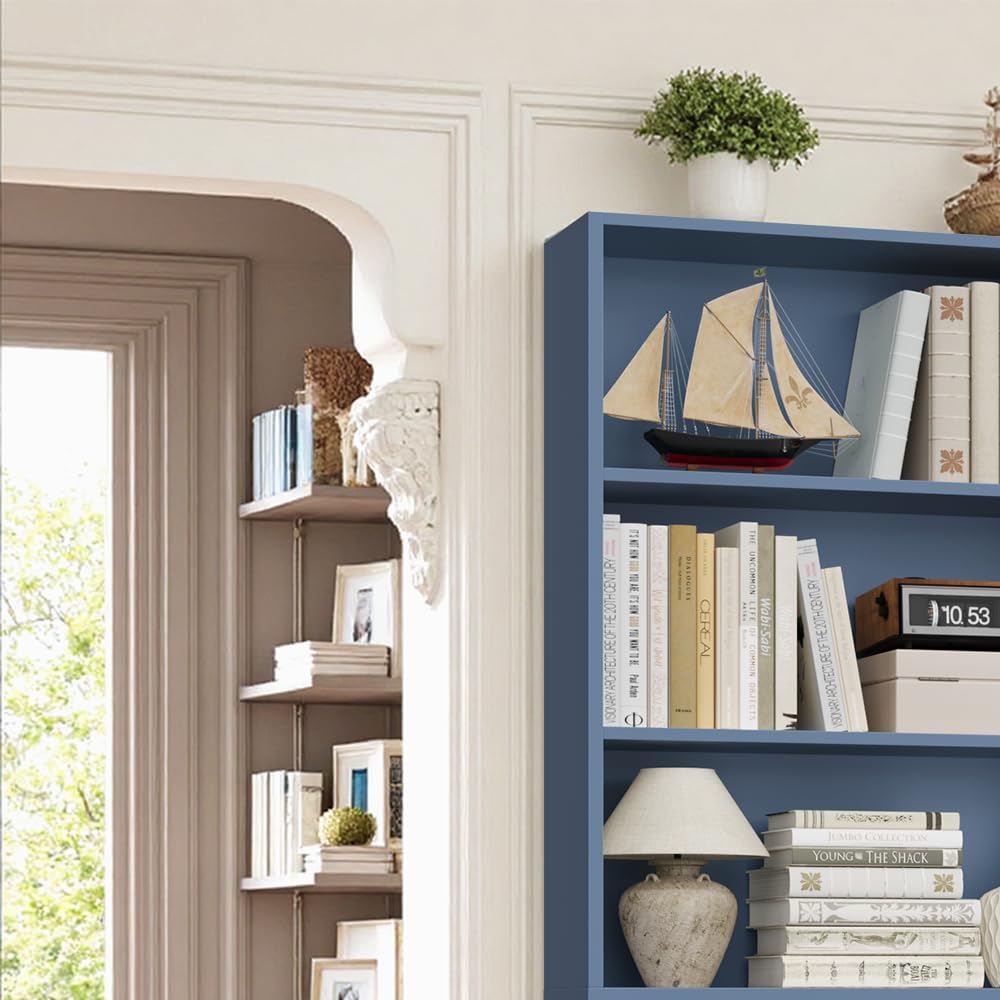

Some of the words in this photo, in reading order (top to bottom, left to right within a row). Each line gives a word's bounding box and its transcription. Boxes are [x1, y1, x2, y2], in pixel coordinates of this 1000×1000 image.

[629, 540, 640, 548] NOT
[629, 550, 640, 559] HOW
[604, 558, 616, 592] CENTURY
[629, 574, 640, 582] YOU
[604, 593, 616, 612] 20TH
[808, 579, 824, 610] CENTURY
[629, 605, 640, 614] HOW
[604, 614, 616, 628] THE
[812, 611, 826, 629] 20TH
[604, 628, 616, 640] OF
[629, 629, 640, 638] YOU
[700, 599, 710, 665] CEREAL
[629, 640, 640, 651] WANT
[604, 640, 616, 692] ARCHITECTURE
[820, 652, 837, 698] ARCHITECTURE
[604, 692, 616, 724] VISIONARY
[828, 698, 842, 729] VISIONARY
[812, 850, 854, 861] YOUNG
[866, 850, 891, 864] THE
[892, 850, 929, 864] SHACK
